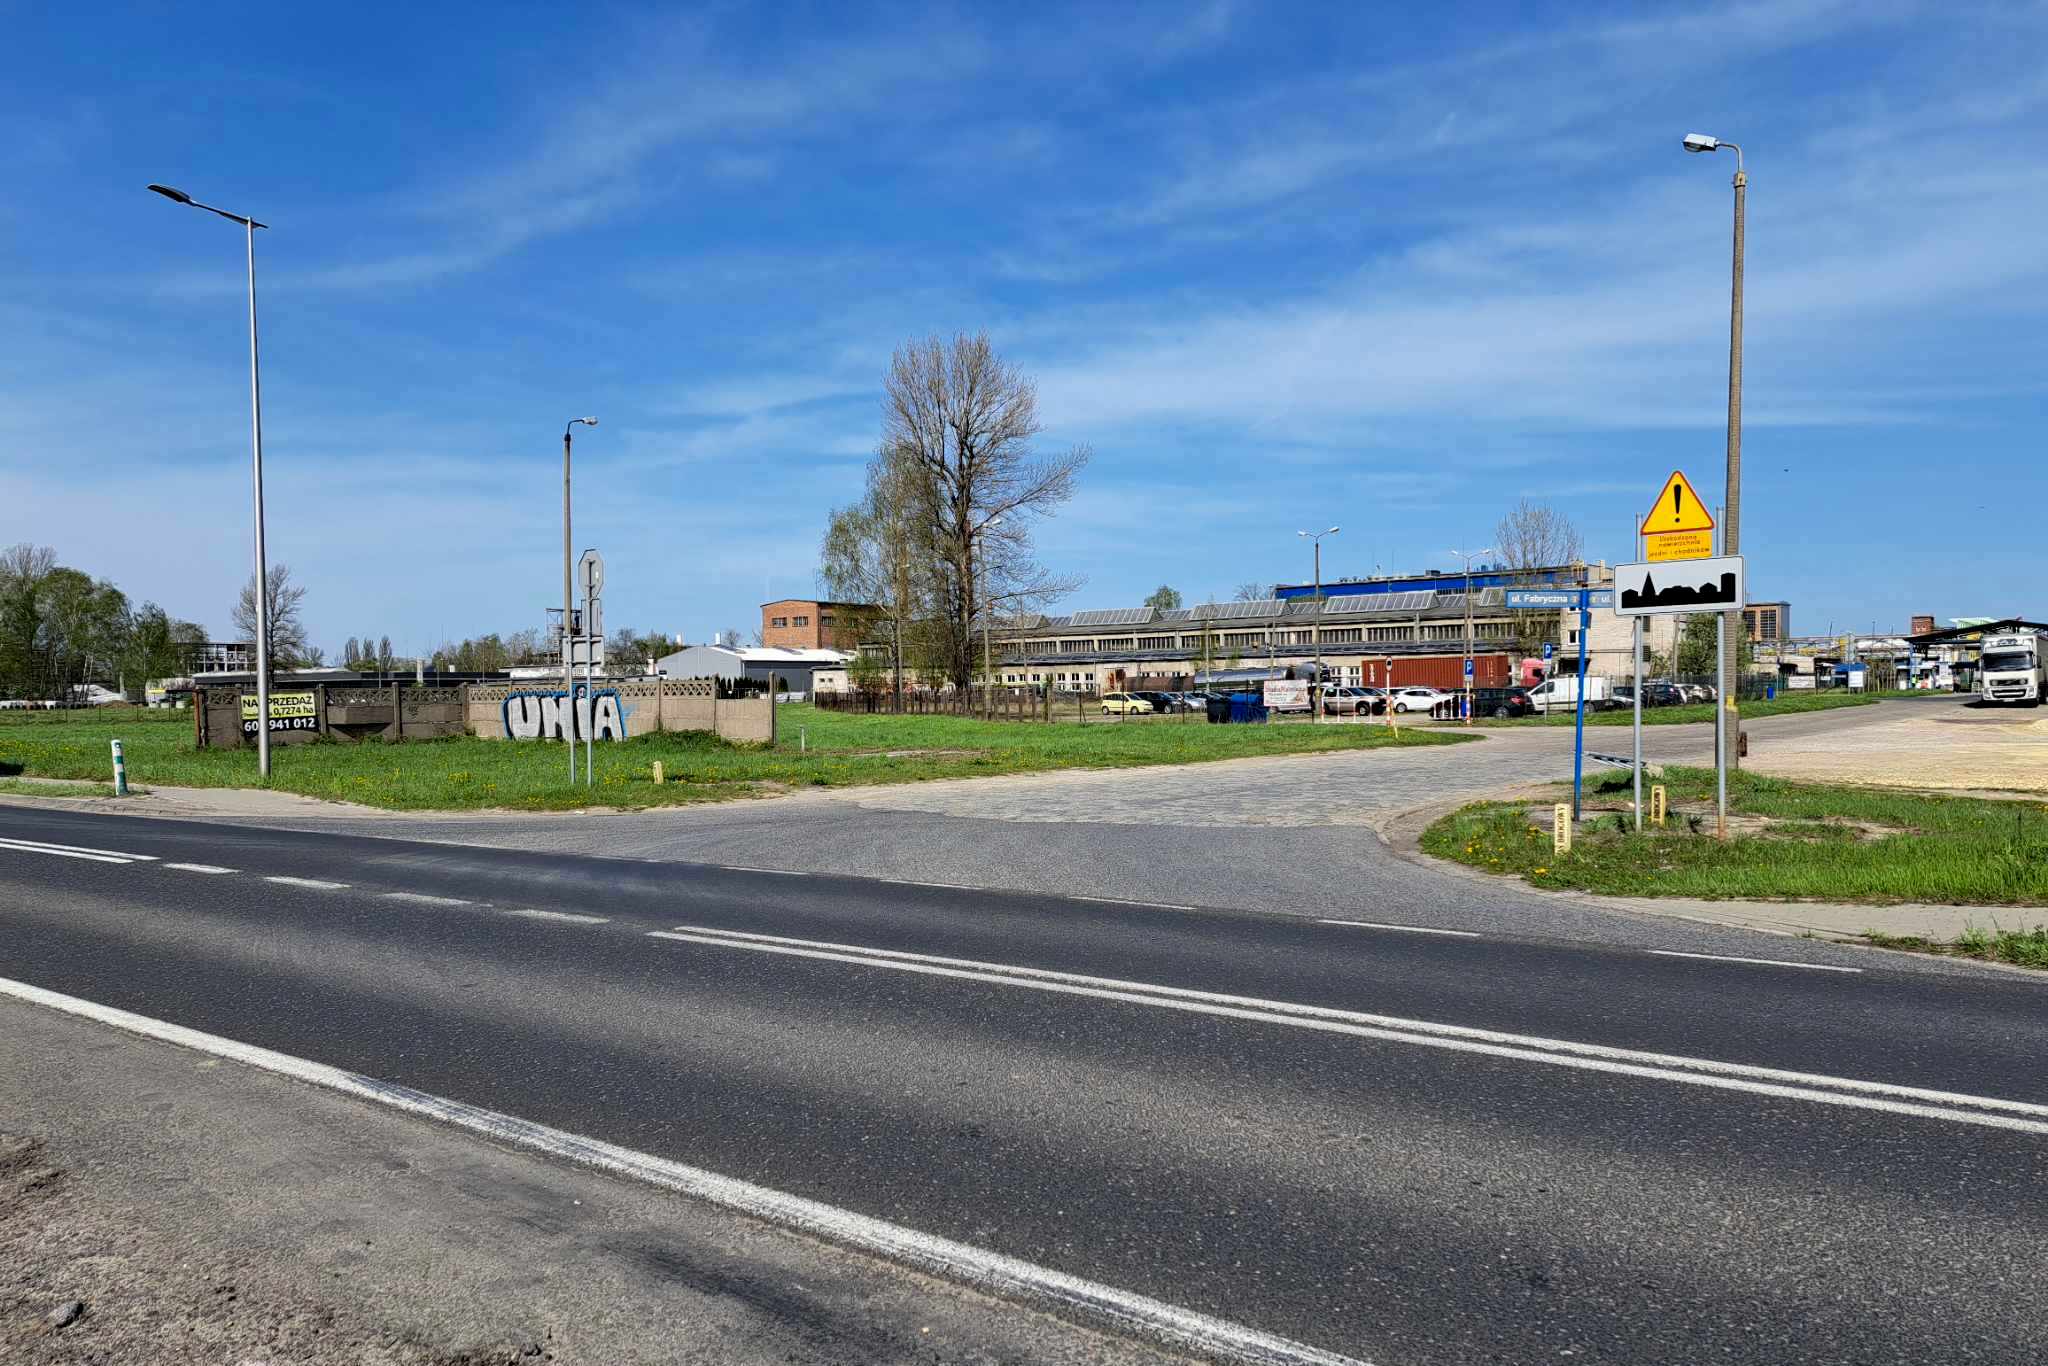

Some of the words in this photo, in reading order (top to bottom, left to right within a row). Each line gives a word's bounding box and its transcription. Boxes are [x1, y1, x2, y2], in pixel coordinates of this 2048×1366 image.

[1511, 594, 1521, 603] ul.
[1523, 594, 1568, 605] Fabryczna
[1466, 661, 1473, 673] P
[242, 699, 258, 708] NA
[303, 705, 314, 714] ha
[505, 693, 625, 741] UNIA
[244, 721, 259, 732] 60
[269, 719, 290, 730] 941
[293, 717, 316, 728] 012
